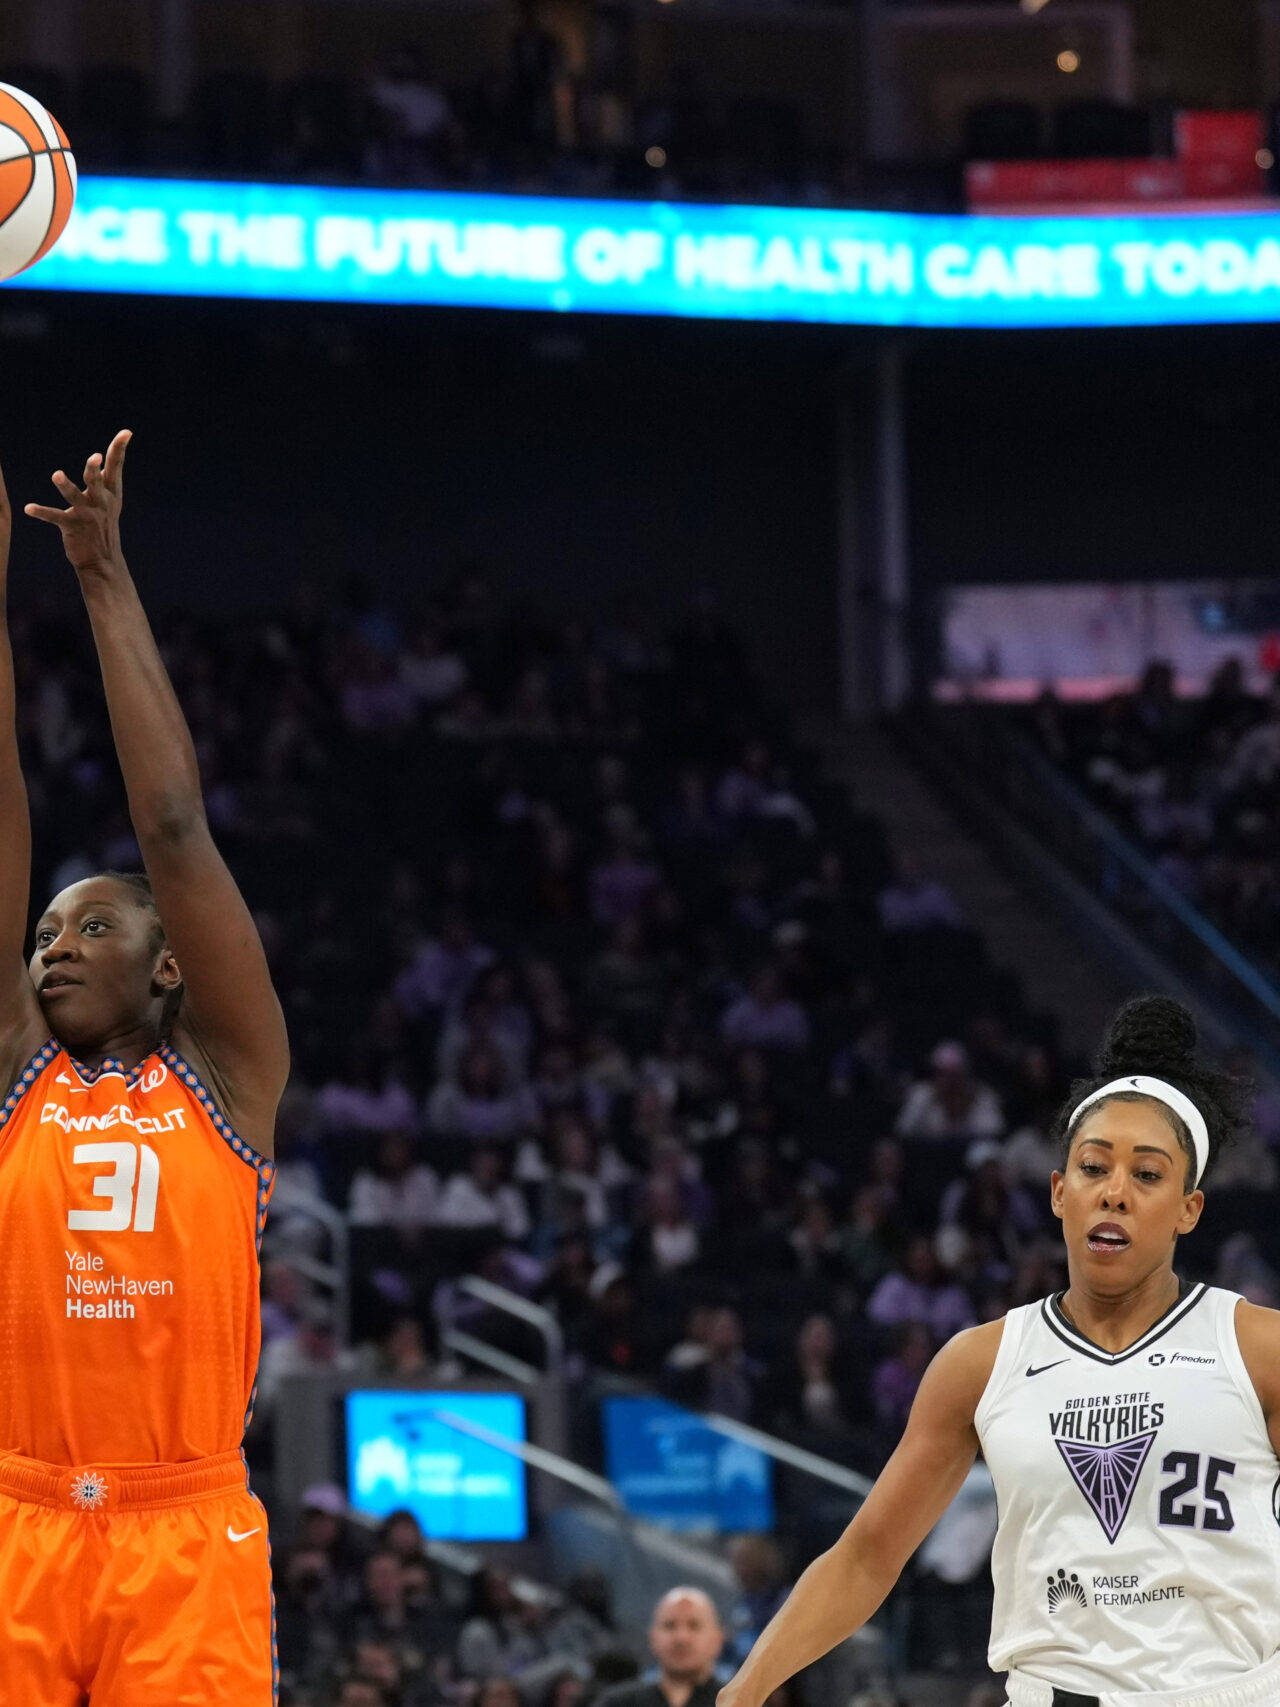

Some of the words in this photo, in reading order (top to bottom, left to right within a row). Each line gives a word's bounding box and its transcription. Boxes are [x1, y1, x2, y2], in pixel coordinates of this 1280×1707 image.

[180, 212, 303, 268] THE
[315, 216, 565, 282] FUTURE
[574, 229, 663, 284] OF
[675, 232, 912, 295] HEALTH
[926, 243, 1103, 298] CARE
[40, 1102, 187, 1135] CONNECCUT
[67, 1141, 160, 1232] 31
[65, 1250, 104, 1272] Yale
[65, 1274, 174, 1296] NewHaven
[65, 1298, 136, 1319] Health
[1170, 1352, 1217, 1366] freedom
[1065, 1395, 1110, 1410] GOLDEN
[1114, 1391, 1151, 1406] STATE
[1048, 1402, 1165, 1444] VALKYRIES
[1156, 1450, 1237, 1534] 25
[1092, 1575, 1140, 1589] KAISER
[1093, 1586, 1186, 1606] PERMANENTE
